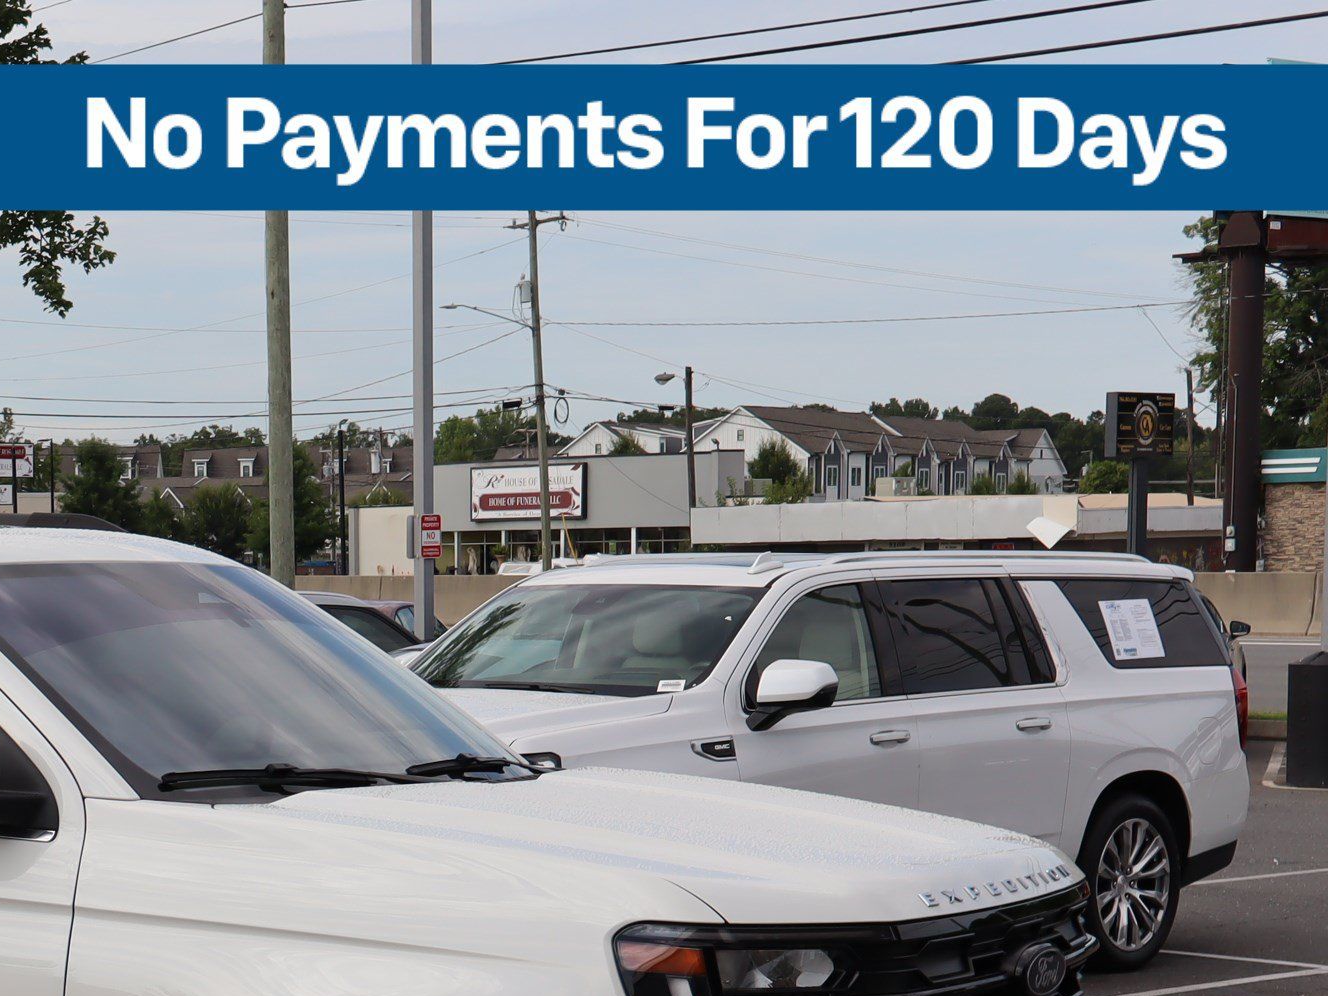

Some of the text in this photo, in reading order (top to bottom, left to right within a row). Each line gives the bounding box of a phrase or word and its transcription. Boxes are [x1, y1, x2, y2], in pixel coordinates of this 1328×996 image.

[488, 497, 506, 507] HOME
[507, 497, 515, 506] OF
[426, 531, 436, 540] NO
[714, 743, 731, 751] GMC
[918, 864, 1071, 908] EXPEDITION
